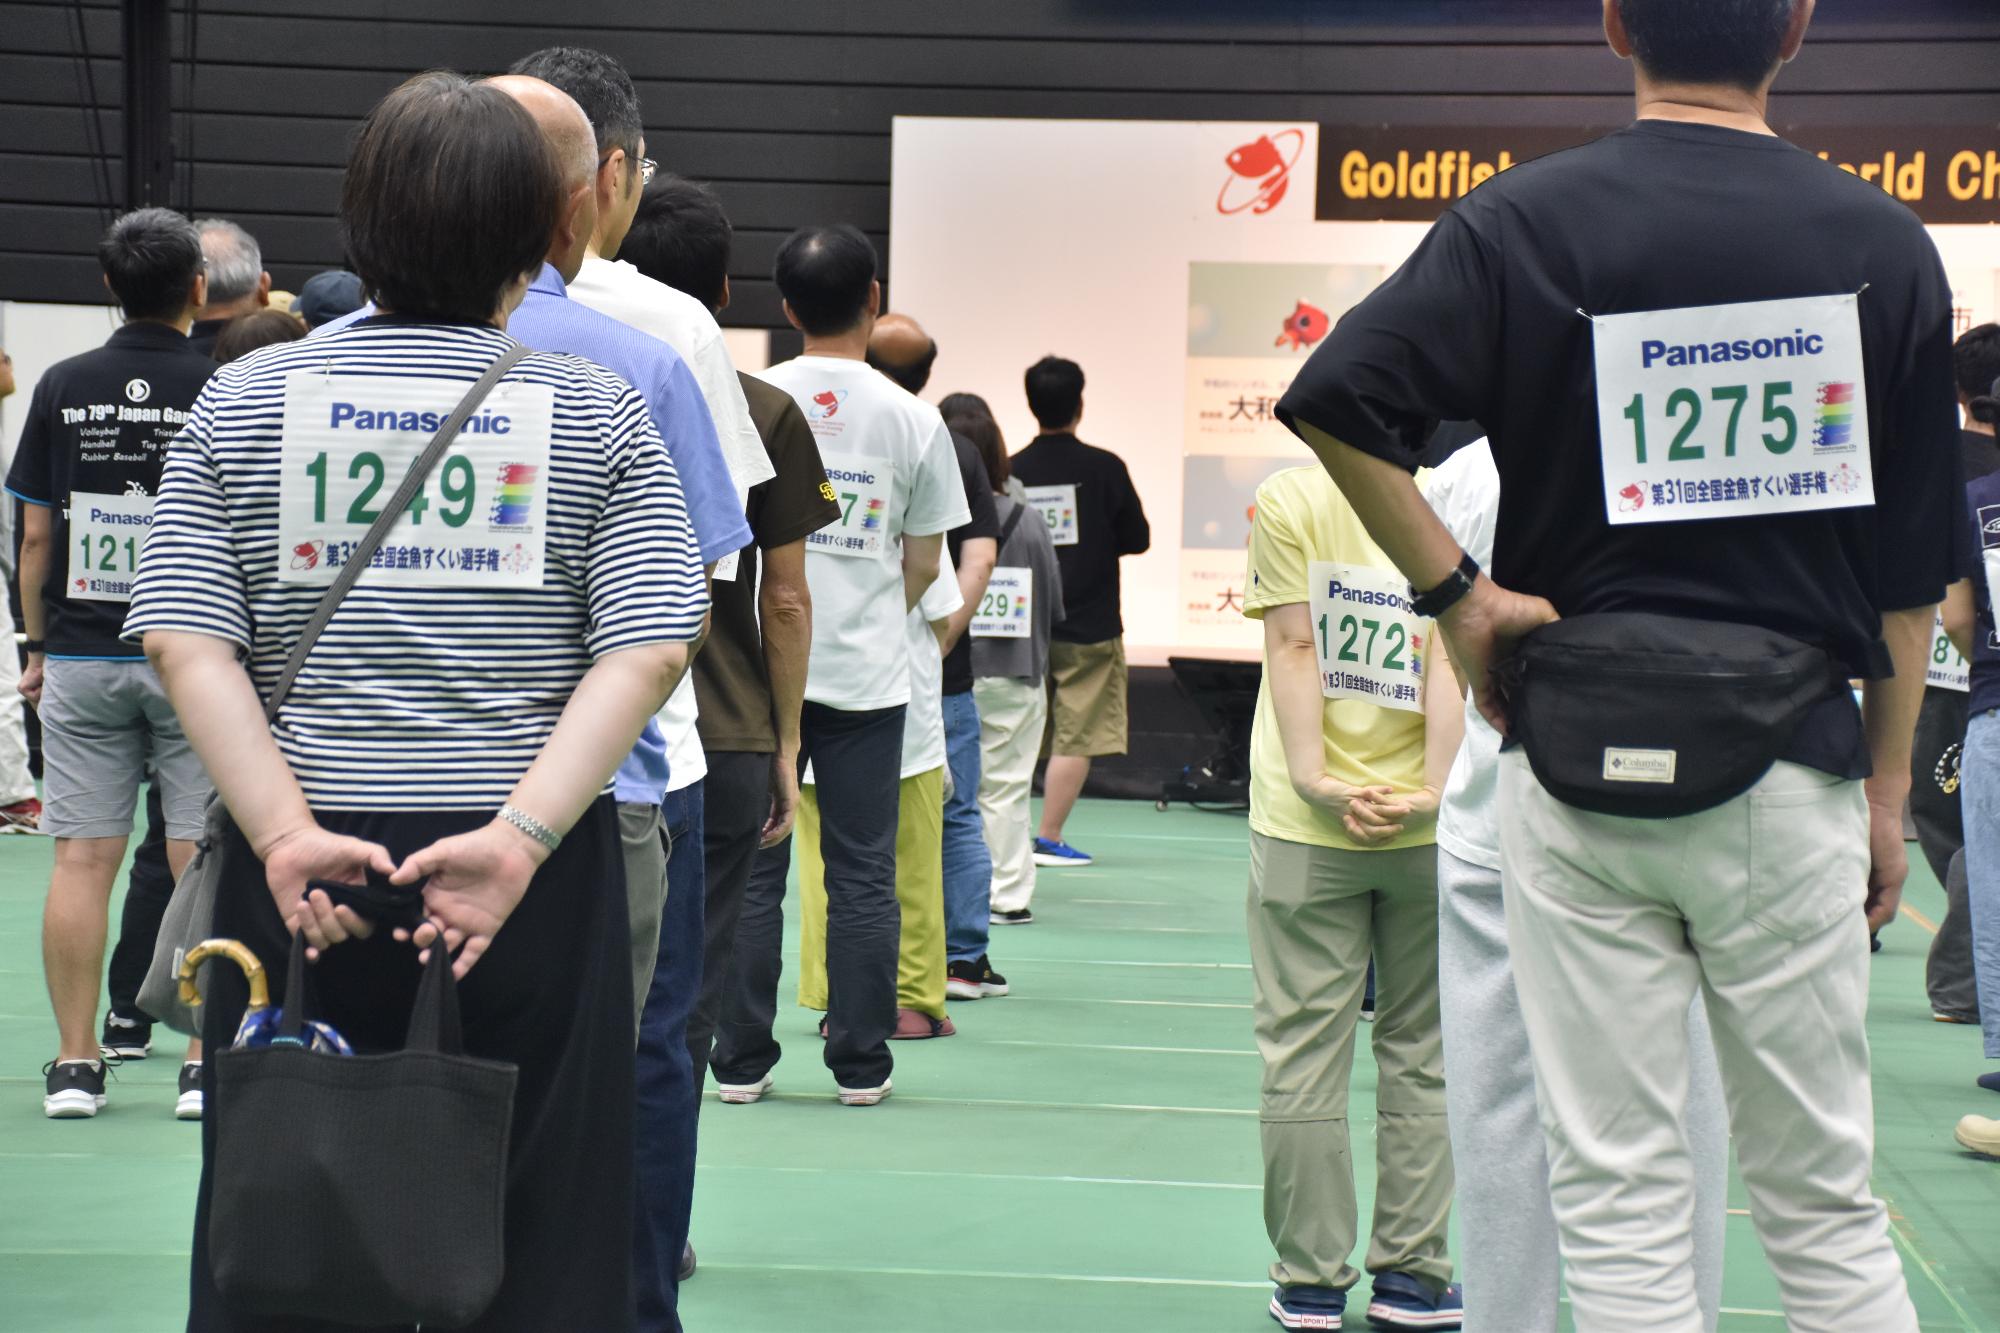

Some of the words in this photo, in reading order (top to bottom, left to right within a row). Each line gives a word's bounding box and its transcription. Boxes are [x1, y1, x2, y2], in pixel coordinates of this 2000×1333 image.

[1817, 150, 1925, 201] rld
[1641, 328, 1824, 368] Panasonic
[61, 407, 86, 424] The
[88, 404, 115, 421] 79th
[117, 405, 161, 422] Japan
[1623, 381, 1798, 464] 1275
[80, 427, 120, 437] Volleyball
[80, 440, 116, 449] Handball
[141, 440, 157, 451] Tug
[81, 453, 110, 462] Rubber
[113, 453, 147, 462] Baseball
[1651, 471, 1828, 506] 第31回全国金魚すくい選手権
[974, 593, 1008, 617] 29
[1328, 580, 1413, 614] Panasonic
[1319, 613, 1405, 671] 1272
[1303, 1317, 1325, 1326] SPORT
